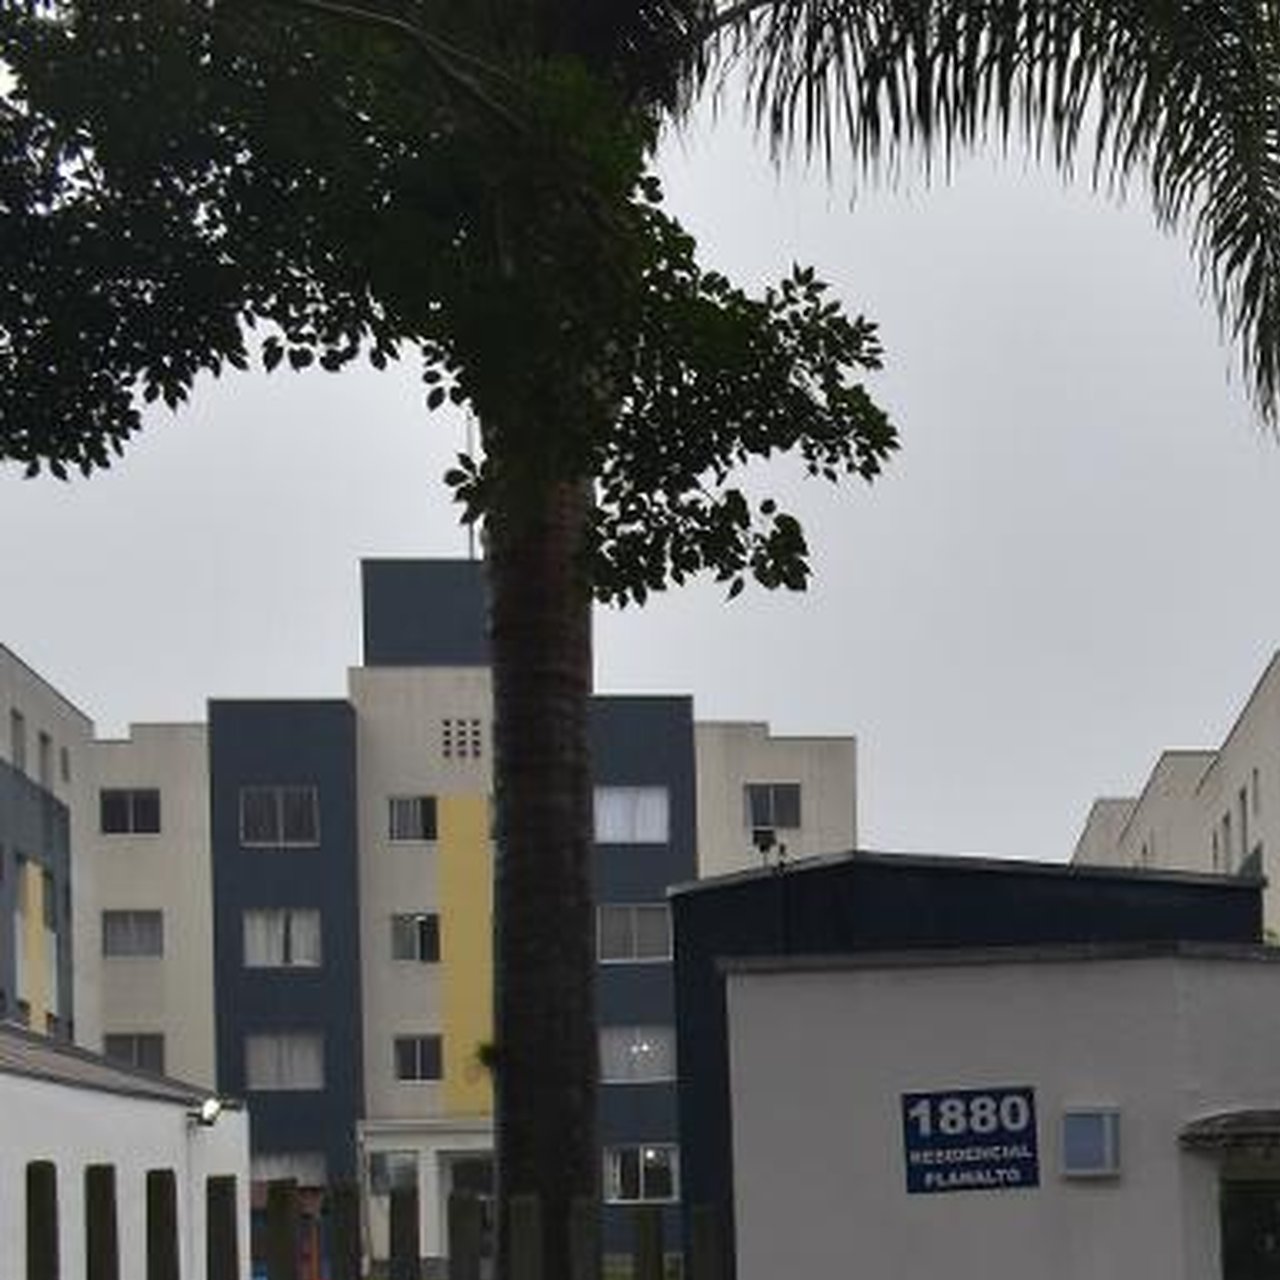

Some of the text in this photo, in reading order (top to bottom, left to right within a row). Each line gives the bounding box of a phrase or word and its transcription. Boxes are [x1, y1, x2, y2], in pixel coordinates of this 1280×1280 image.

[908, 1094, 1031, 1137] 1880
[909, 1144, 1034, 1165] RESIDENCIAL
[923, 1167, 1022, 1188] PLANALTO
